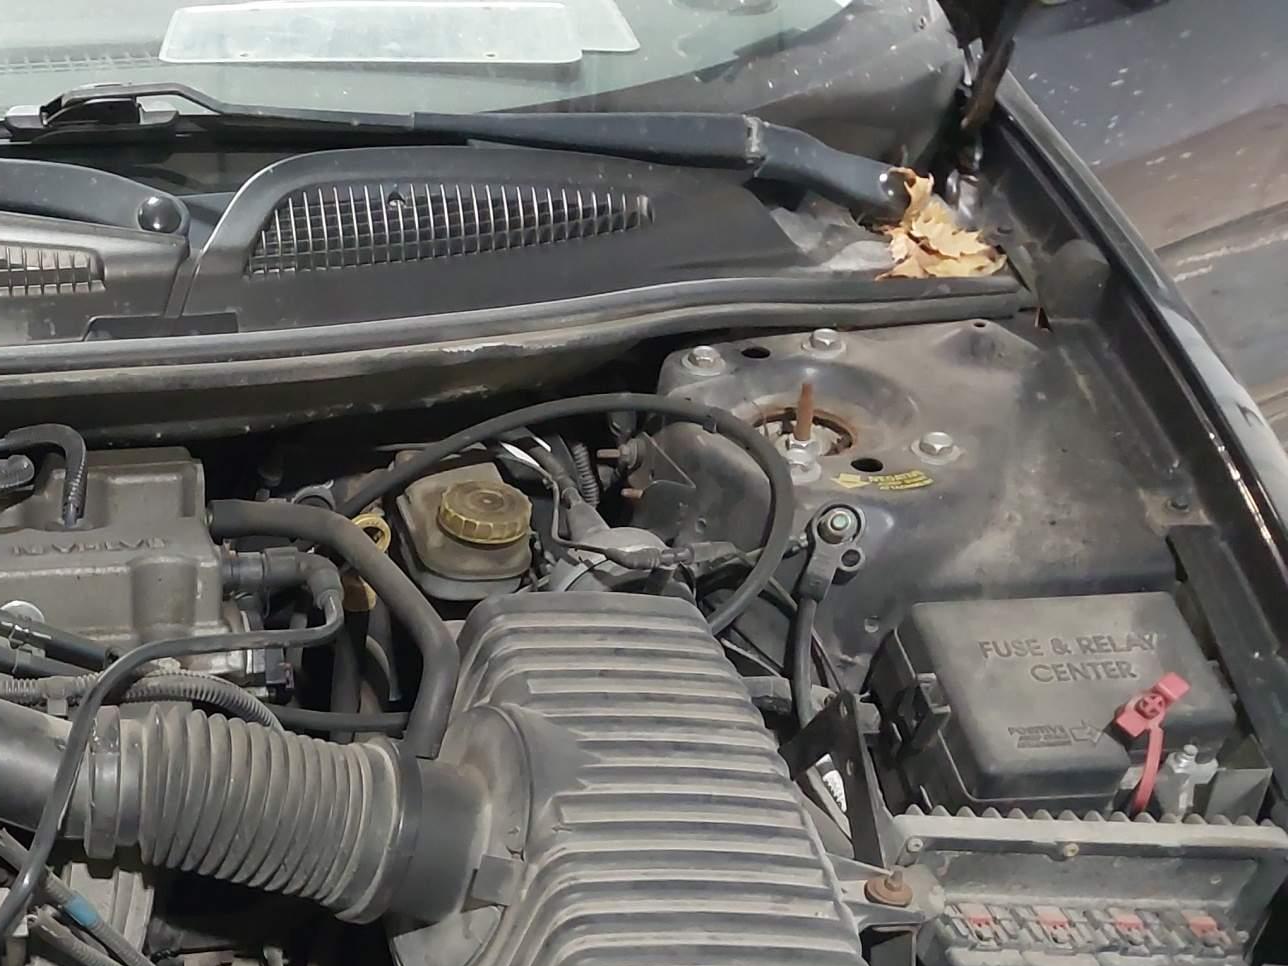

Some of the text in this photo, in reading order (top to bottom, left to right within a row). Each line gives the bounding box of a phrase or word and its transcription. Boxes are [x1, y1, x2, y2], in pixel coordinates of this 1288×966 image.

[979, 632, 1158, 658] FUSE & RELAY
[1030, 661, 1138, 682] CENTER
